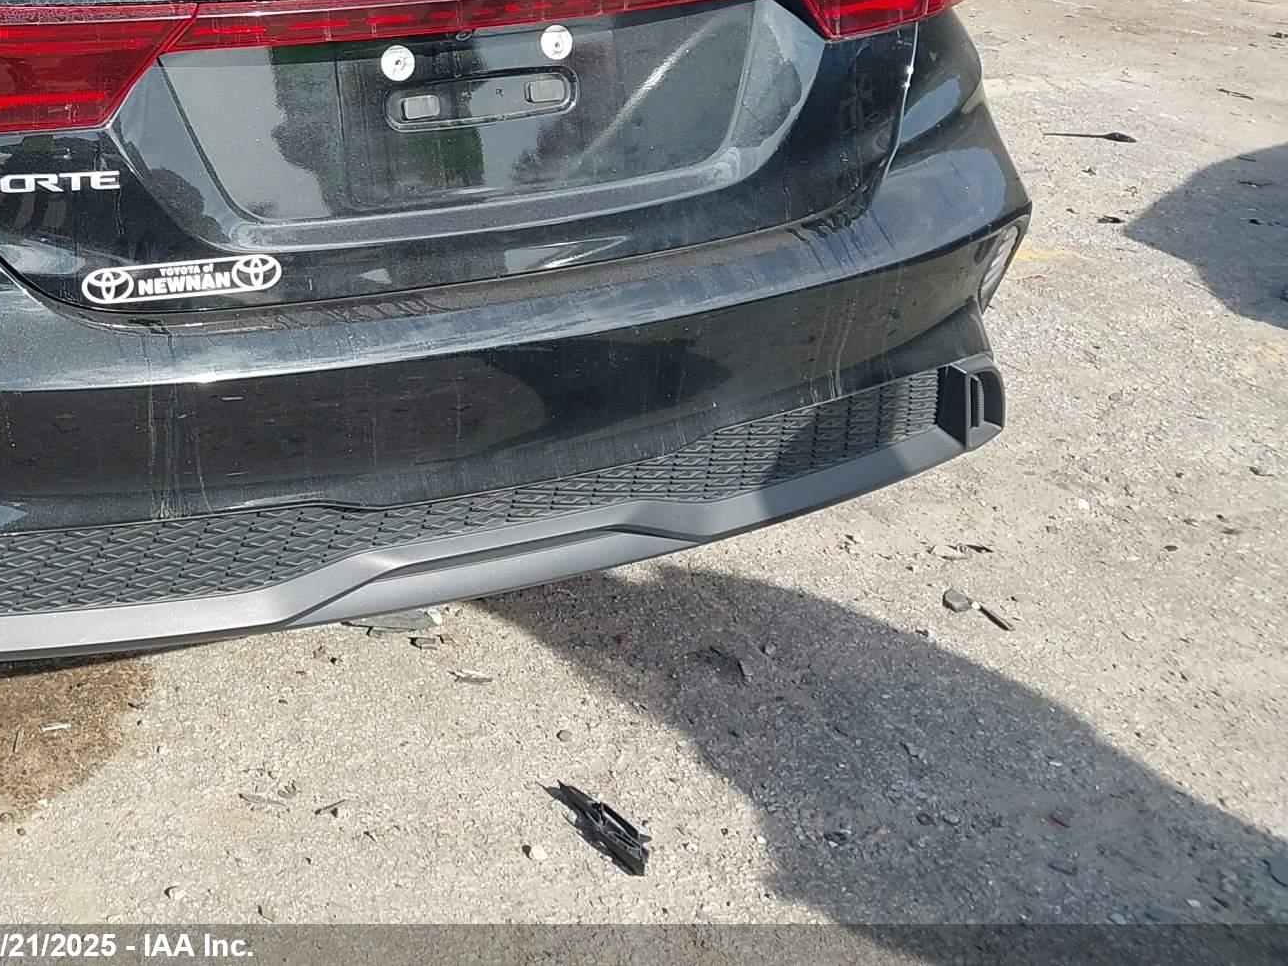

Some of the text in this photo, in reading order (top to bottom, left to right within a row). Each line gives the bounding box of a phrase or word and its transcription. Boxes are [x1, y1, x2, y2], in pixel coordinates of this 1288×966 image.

[159, 263, 214, 277] TOYOTA of
[138, 271, 231, 296] NEWNAN
